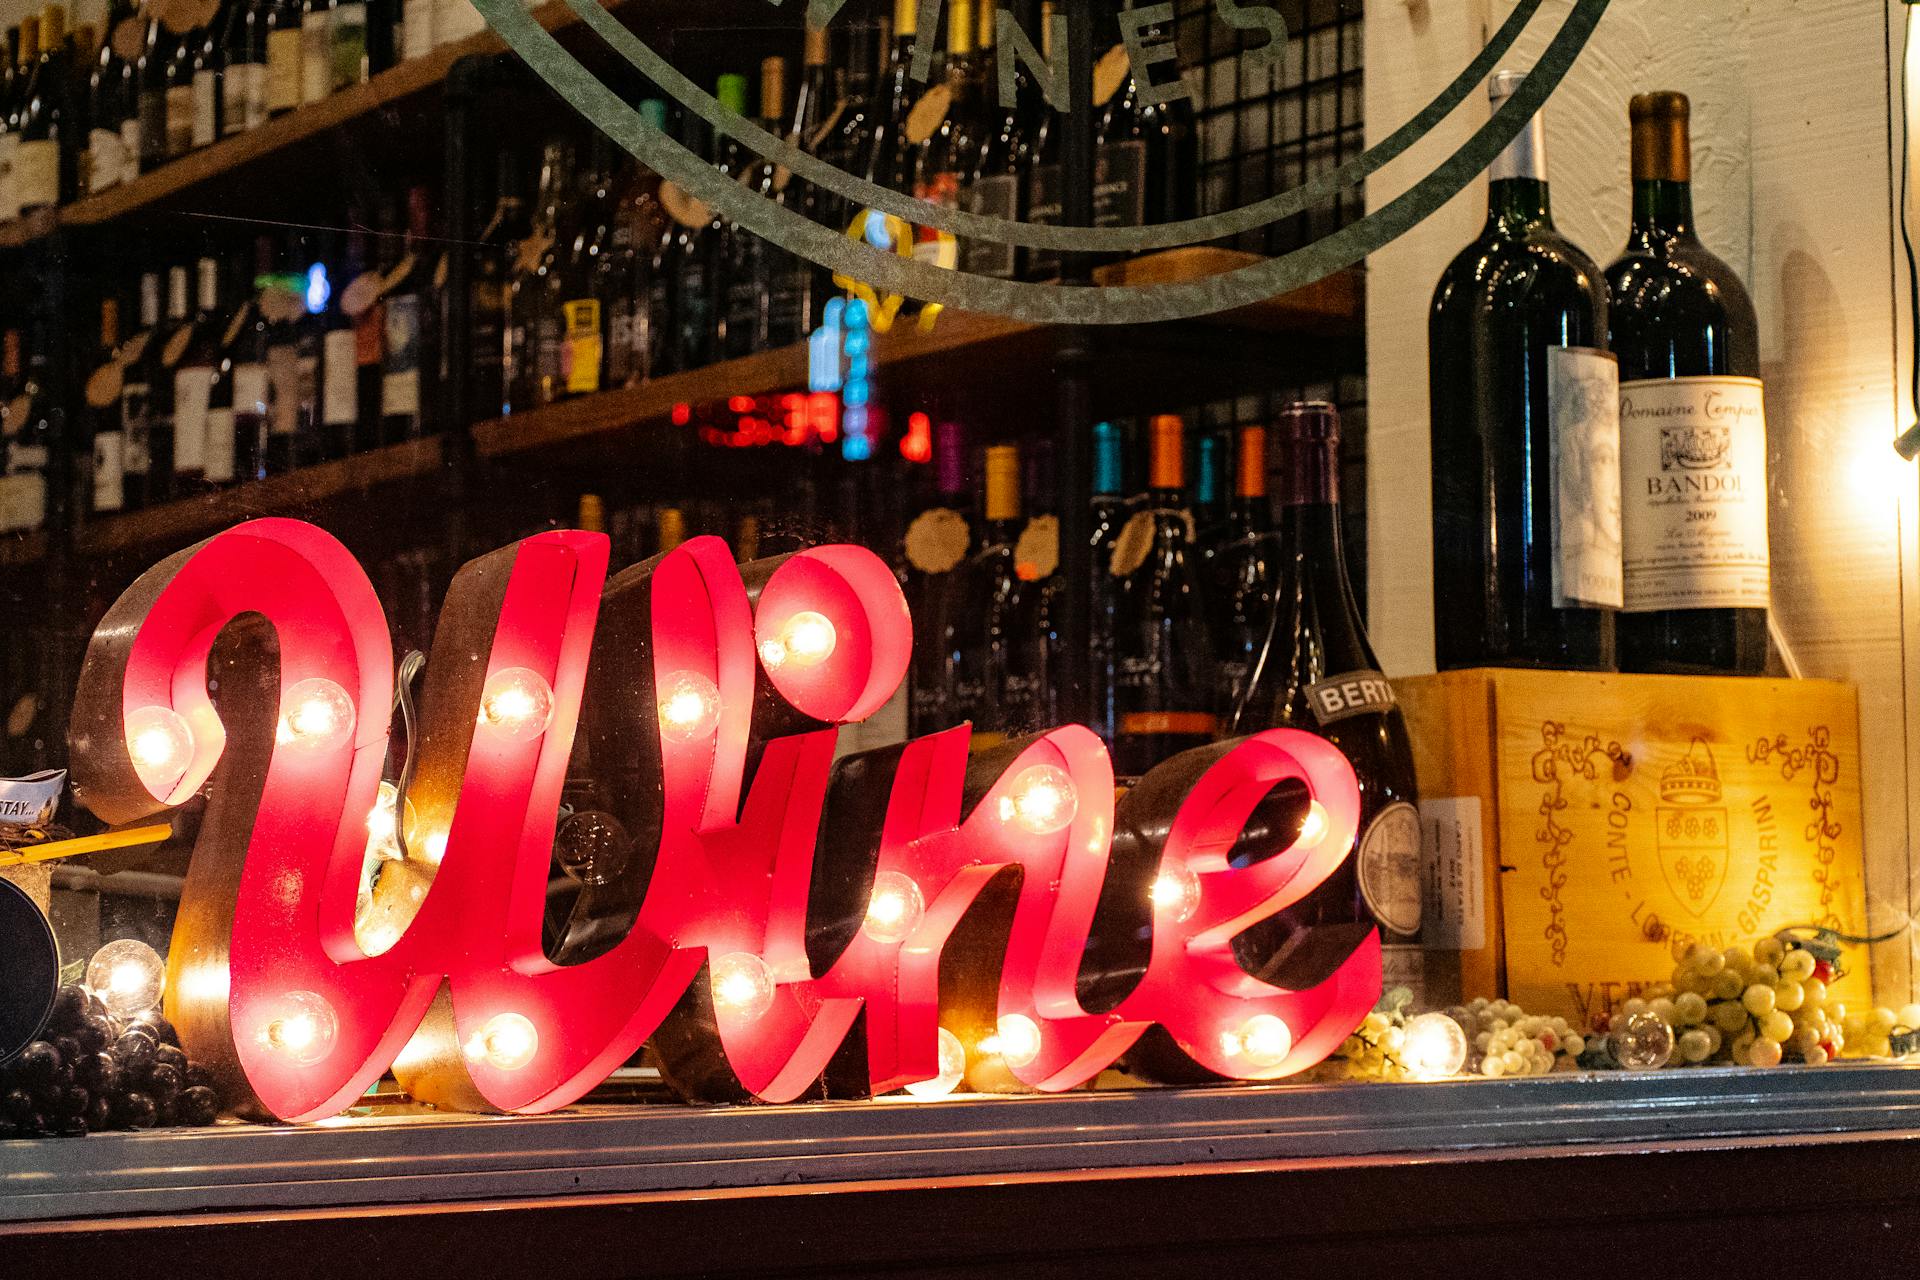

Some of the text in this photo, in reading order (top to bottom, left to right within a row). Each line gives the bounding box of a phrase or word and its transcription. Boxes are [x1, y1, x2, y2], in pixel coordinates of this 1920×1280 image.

[766, 0, 1291, 113] INES
[1619, 395, 1695, 421] Domaine
[1685, 510, 1717, 523] 2009
[0, 800, 35, 816] TAY...
[78, 515, 1383, 1122] Wine
[1607, 791, 1632, 885] CONTE
[1737, 795, 1778, 935] GASPARINI
